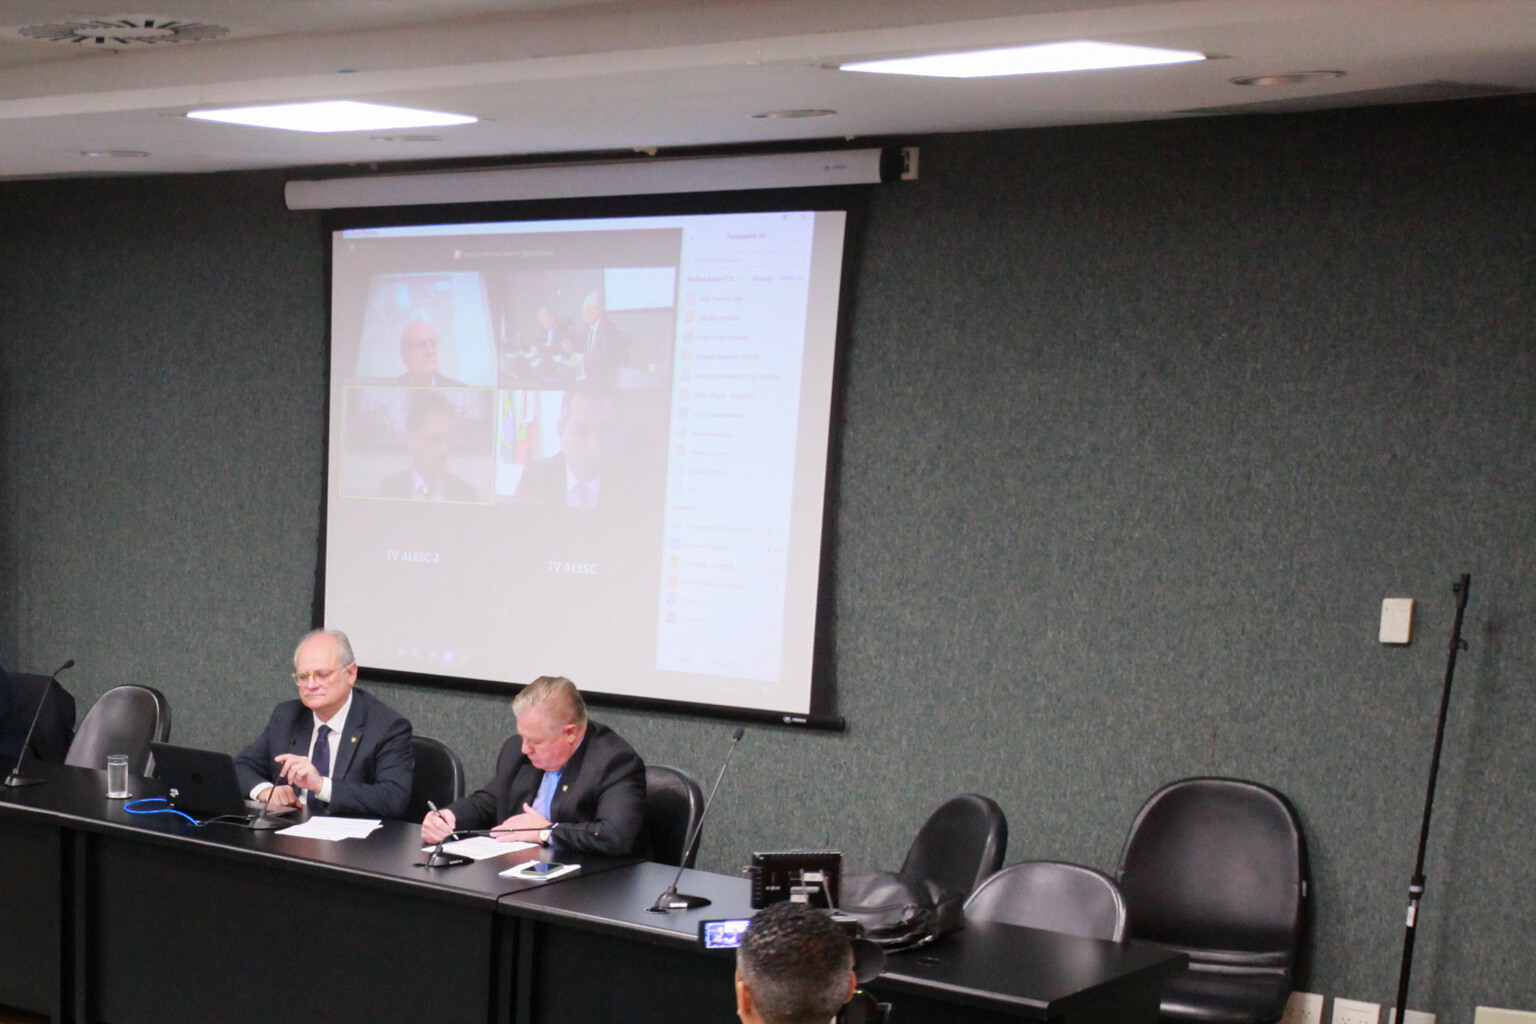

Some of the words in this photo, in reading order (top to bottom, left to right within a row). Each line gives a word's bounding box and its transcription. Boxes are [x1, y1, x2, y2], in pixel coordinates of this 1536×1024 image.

[385, 550, 400, 561] TV
[401, 551, 432, 563] ALESC
[547, 560, 562, 572] TV
[563, 562, 597, 575] ALESC
